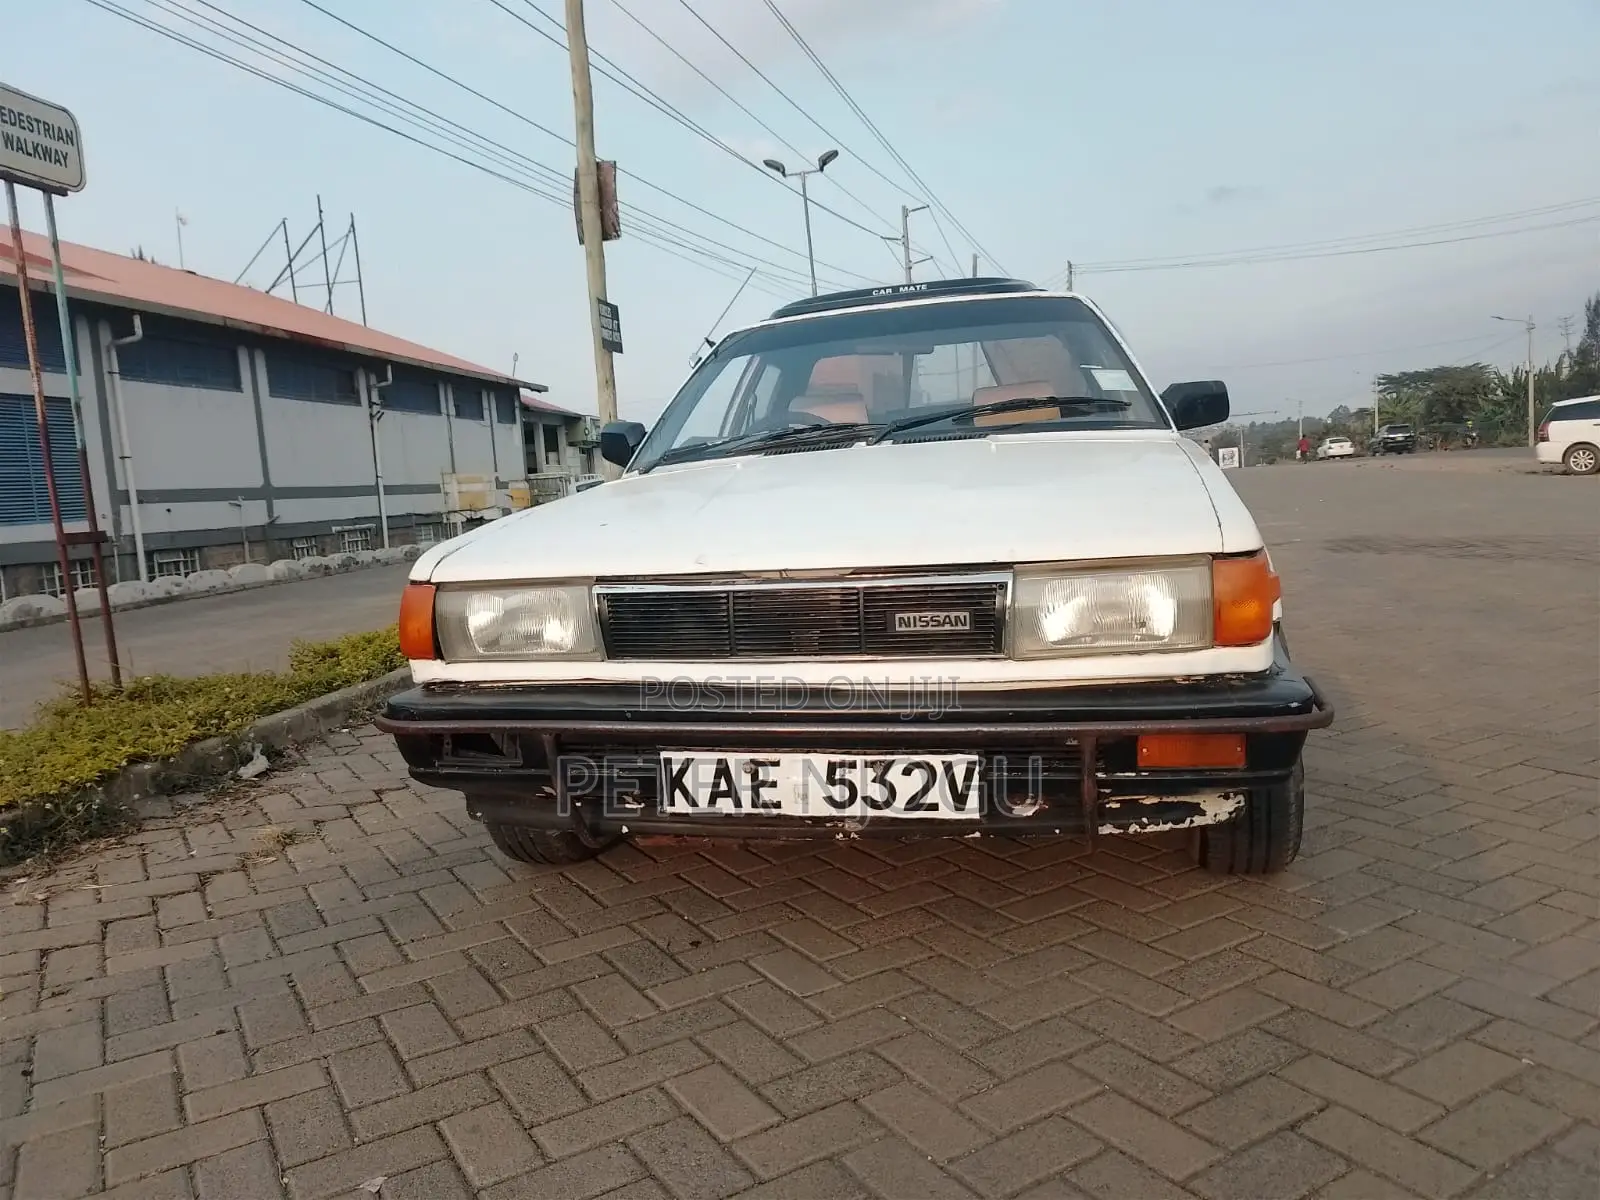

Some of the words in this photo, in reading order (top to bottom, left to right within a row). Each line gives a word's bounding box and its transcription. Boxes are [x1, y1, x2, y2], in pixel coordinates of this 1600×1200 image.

[0, 105, 75, 147] EDESTRIAN
[1, 130, 69, 168] WALKWAY
[872, 288, 893, 296] CAR
[899, 284, 928, 293] MATE
[898, 614, 968, 628] NISSAN
[662, 757, 782, 809] KAE
[822, 758, 978, 812] 532V
